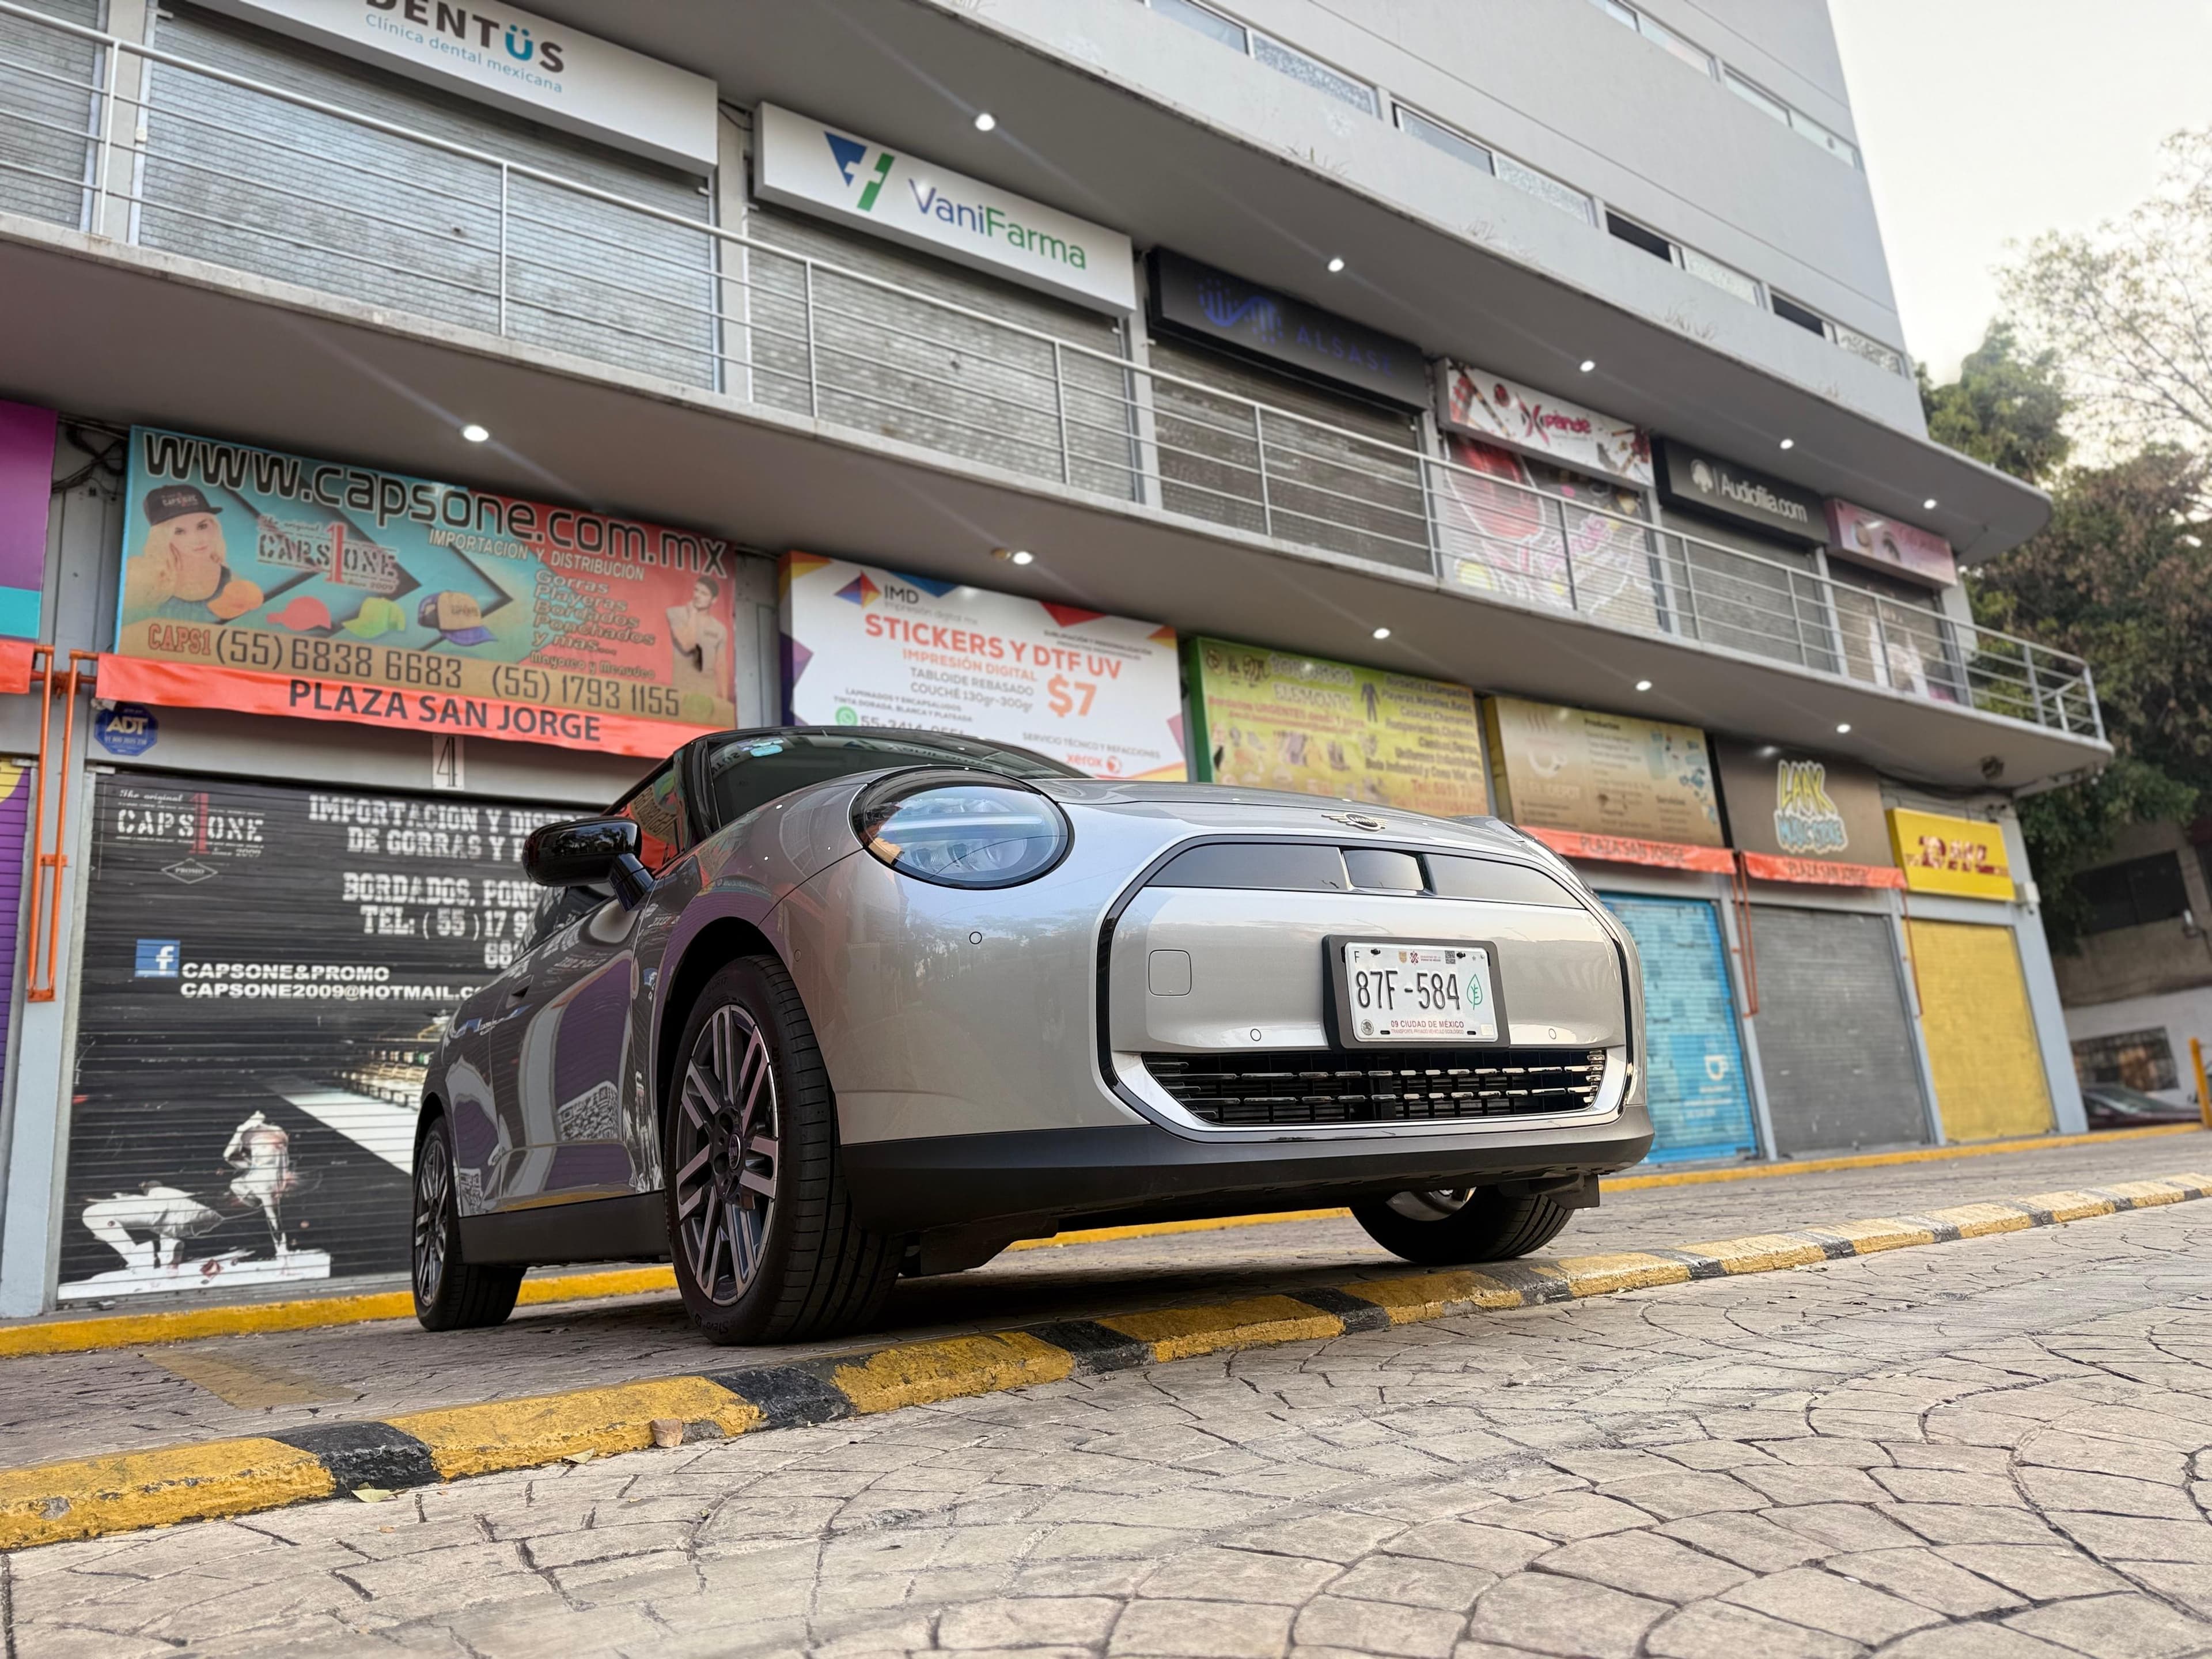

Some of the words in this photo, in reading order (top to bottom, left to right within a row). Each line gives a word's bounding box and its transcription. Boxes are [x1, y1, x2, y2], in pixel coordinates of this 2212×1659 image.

[366, 0, 565, 74] ENTÜS
[366, 13, 424, 44] Clínica
[429, 35, 482, 65] dental
[487, 58, 562, 93] mexicana
[908, 178, 1086, 270] VaniFarma
[143, 432, 728, 579] www.capsone.com.mx
[536, 548, 546, 562] Y
[534, 584, 628, 612] Playeras
[536, 569, 609, 594] Gorras
[884, 584, 919, 604] IMD
[533, 600, 640, 628] Bordados
[533, 613, 656, 646] Ponchados
[532, 631, 547, 647] y
[865, 612, 1005, 660] STICKERS
[1010, 639, 1027, 662] Y
[1033, 645, 1082, 672] DTF
[1087, 655, 1123, 680] UV
[148, 623, 211, 656] CAPS1
[217, 628, 283, 670] (55)
[291, 638, 373, 678] 6838
[385, 652, 462, 689] 6683
[492, 664, 550, 704] (55)
[562, 674, 621, 710] 1793
[631, 683, 680, 717] 1155
[589, 662, 596, 675] y
[903, 648, 982, 672] IMPRESIÓN
[985, 662, 1037, 682] DIGITAL
[910, 666, 969, 687] TABLOIDE
[971, 677, 1035, 696] REBASADO
[290, 679, 408, 720] PLAZA
[419, 695, 487, 729] SAN
[497, 703, 601, 743] JORGE
[1047, 673, 1097, 718] $7
[106, 716, 148, 735] ADT
[436, 736, 458, 788] 4
[1067, 753, 1103, 768] xerox
[144, 794, 183, 804] original
[309, 794, 478, 832] IMPORTACION
[486, 809, 502, 834] Y
[347, 826, 380, 854] DE
[387, 829, 482, 861] GORRAS
[489, 836, 505, 861] Y
[360, 904, 415, 935] TEL:
[484, 910, 507, 938] 17
[181, 963, 390, 982] CAPSONE&PROMO
[1354, 950, 1360, 963] F
[1356, 970, 1461, 1010] 87F-584
[1439, 1019, 1464, 1028] MÉXICO
